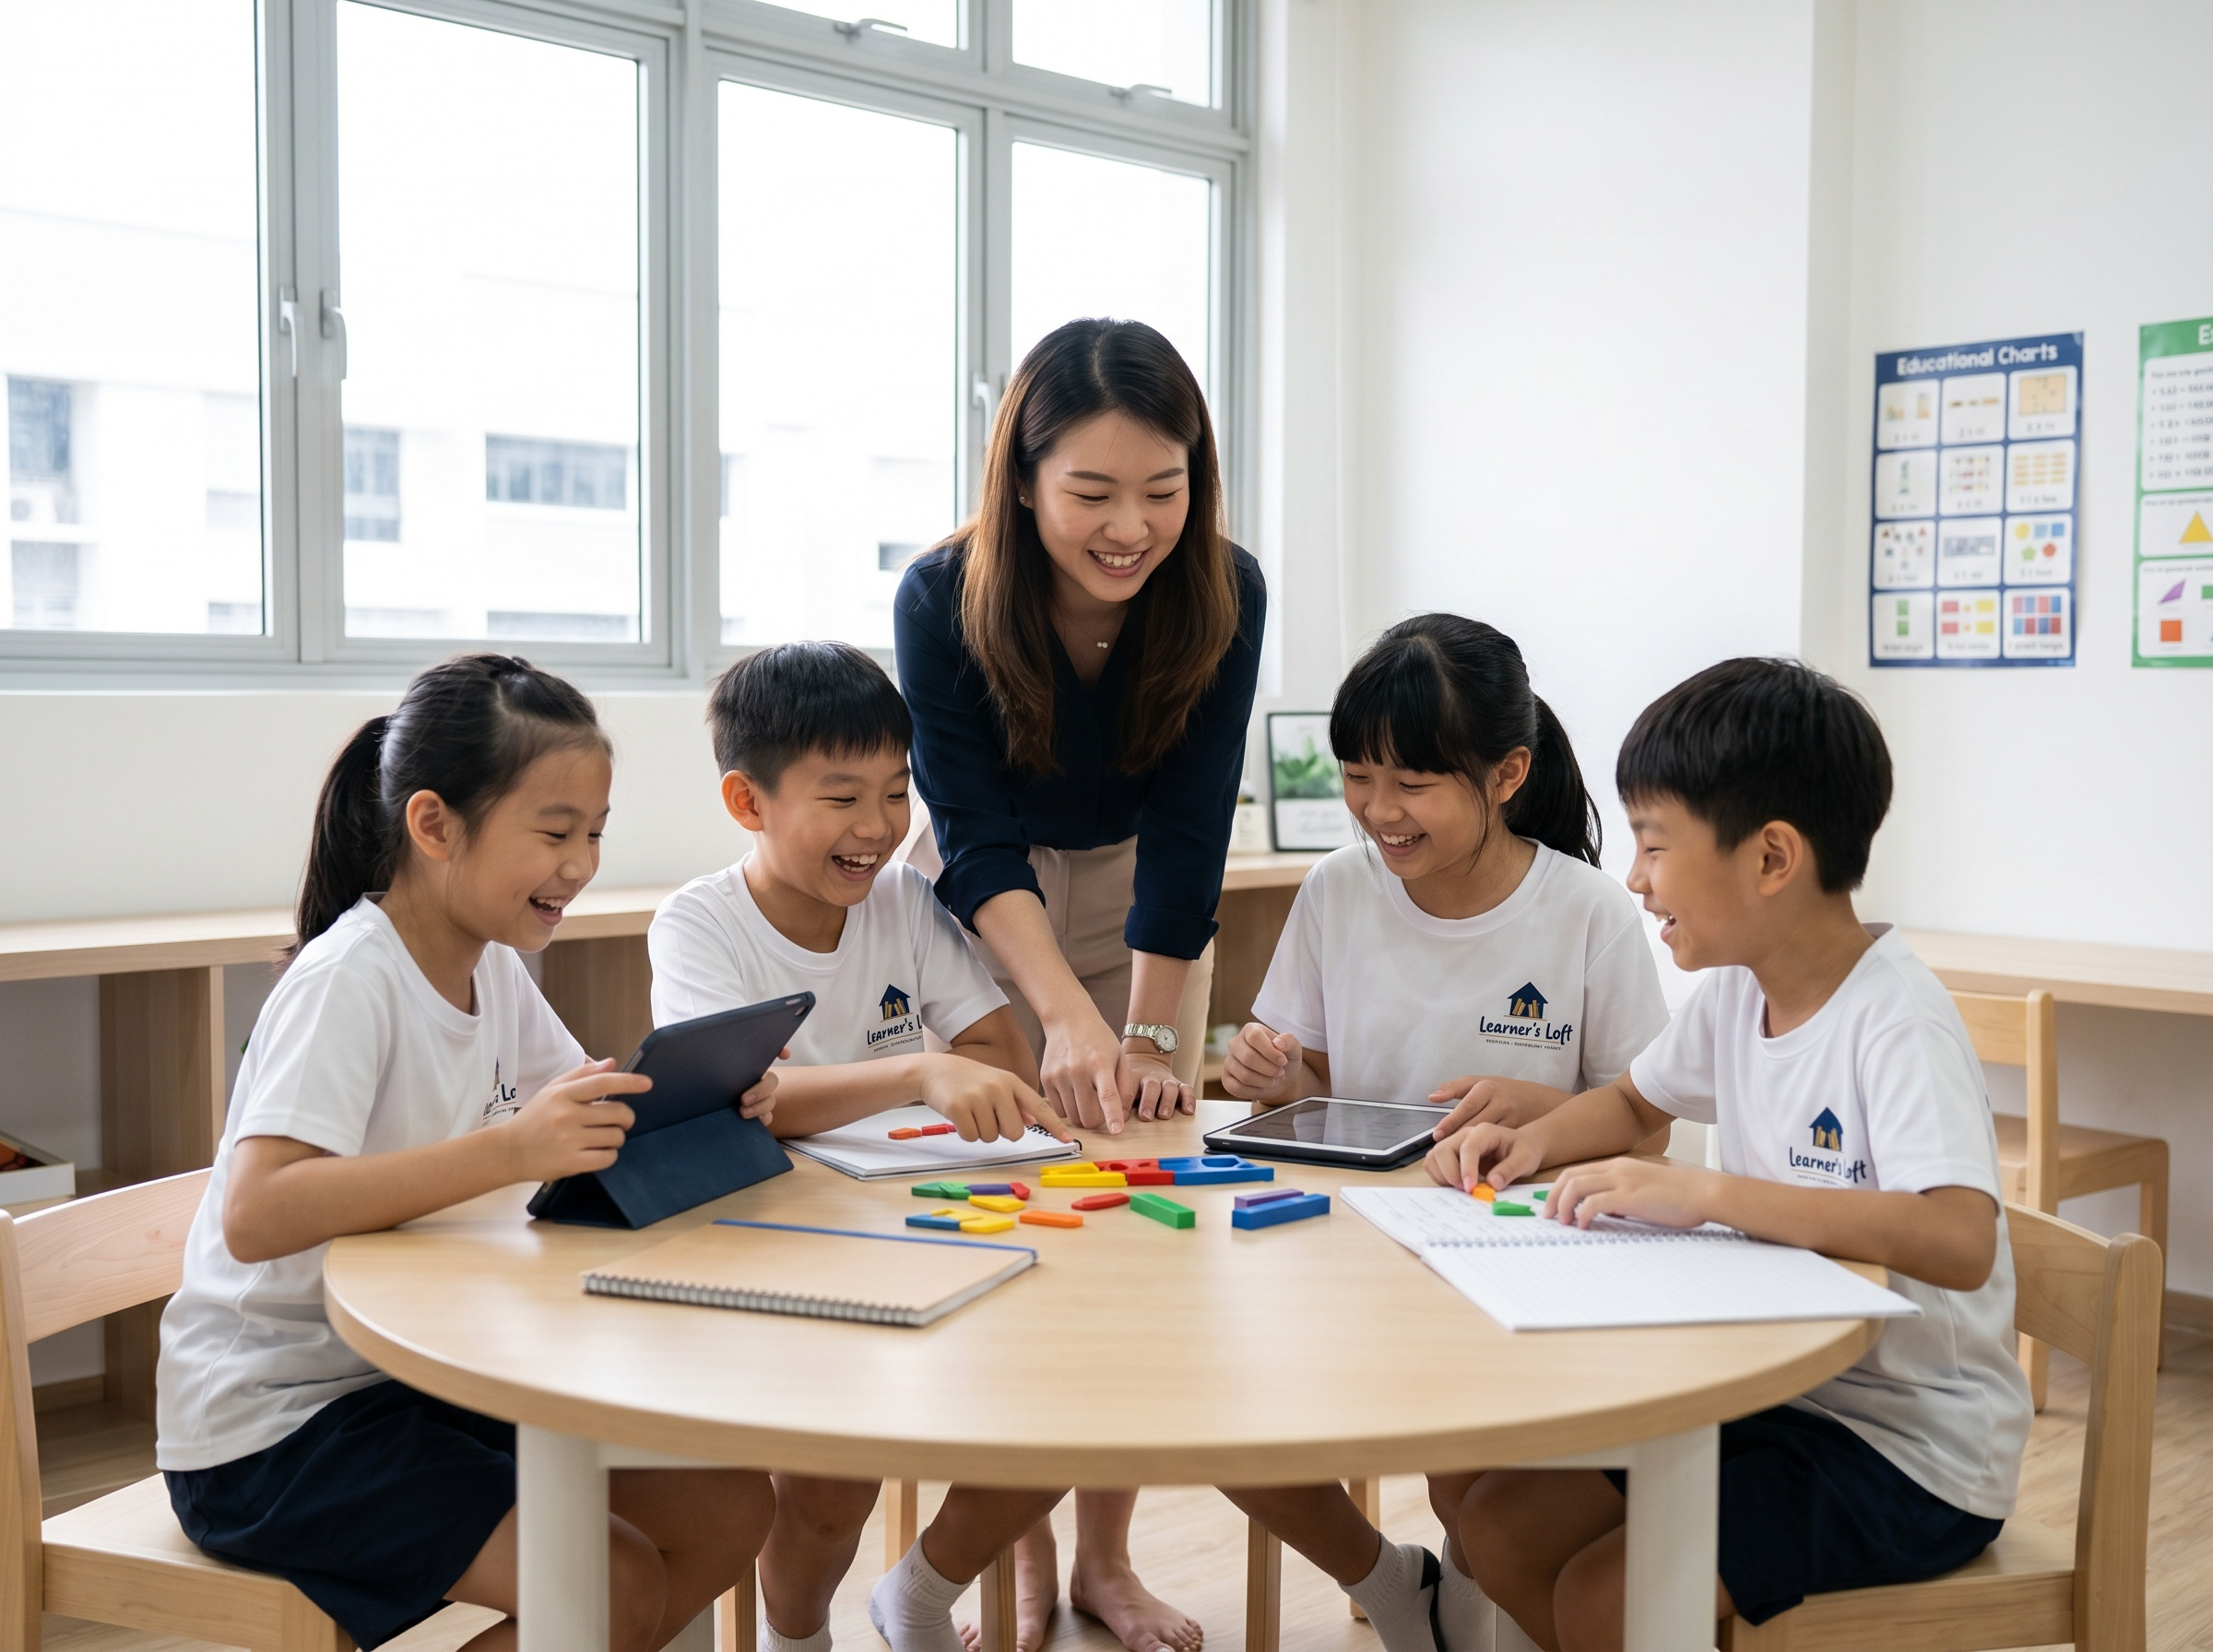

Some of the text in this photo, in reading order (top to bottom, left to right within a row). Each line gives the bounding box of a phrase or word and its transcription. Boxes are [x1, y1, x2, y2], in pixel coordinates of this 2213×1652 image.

[2198, 323, 2213, 346] E
[1896, 342, 2058, 376] Educational Charts
[1479, 1015, 1541, 1038] Learner's
[1545, 1022, 1573, 1045] Loft
